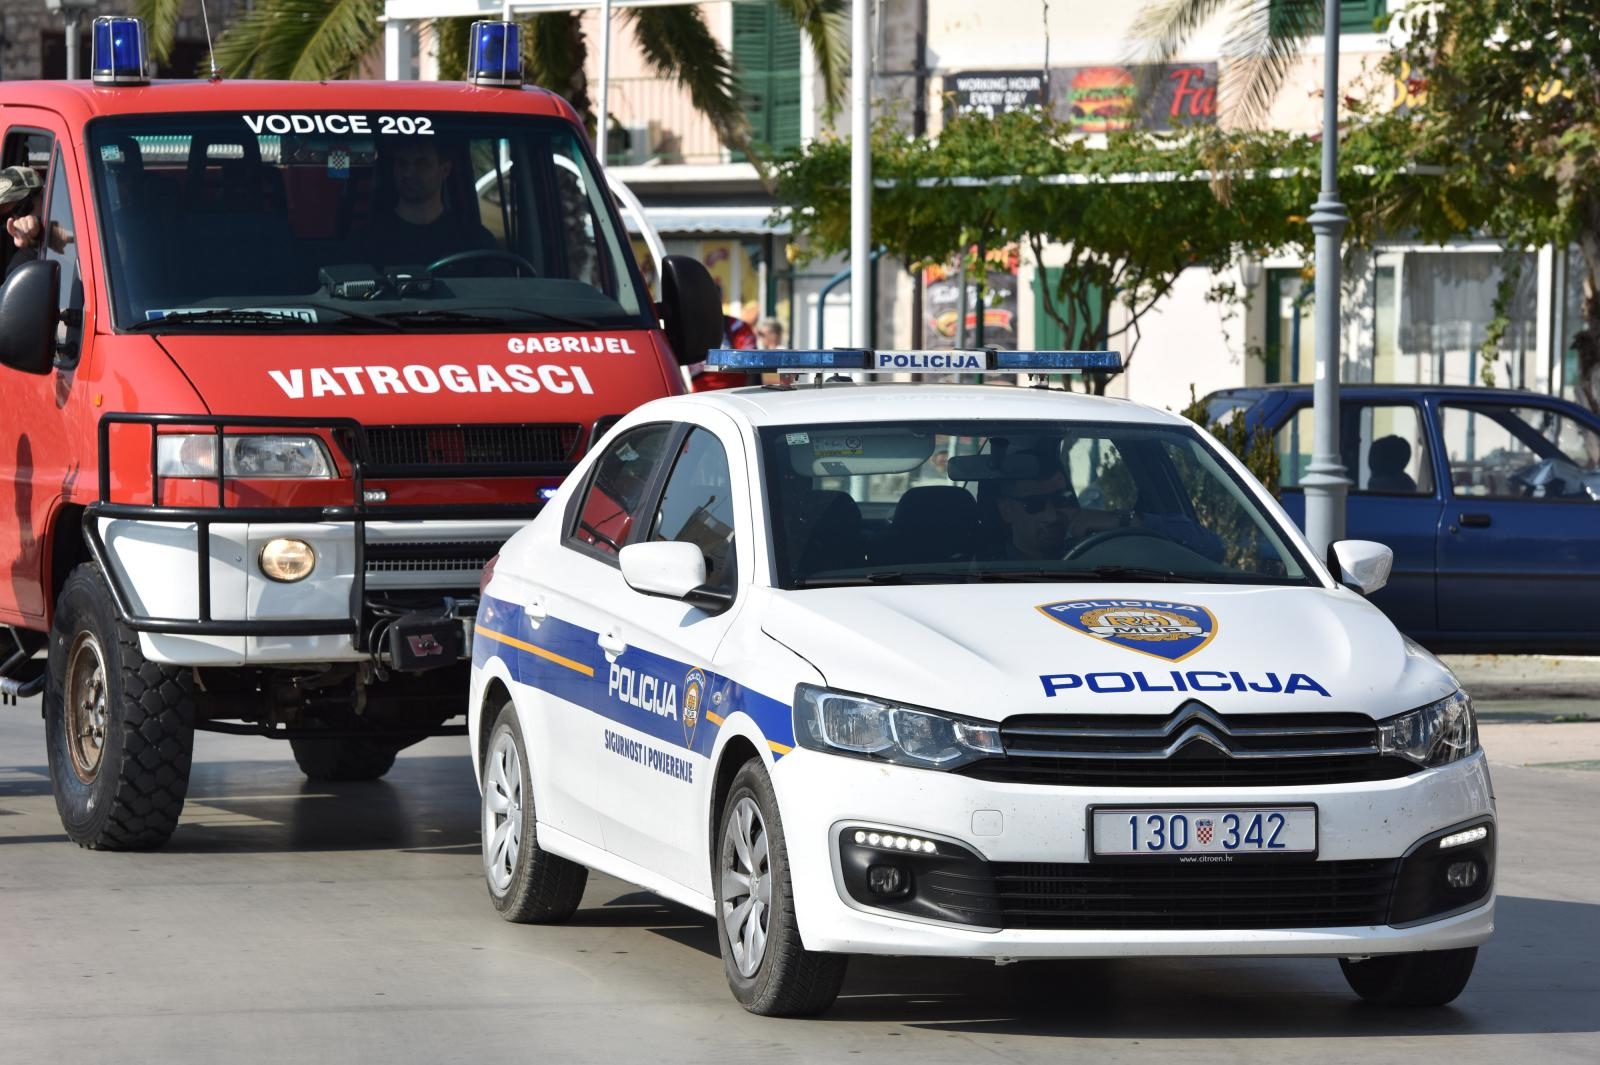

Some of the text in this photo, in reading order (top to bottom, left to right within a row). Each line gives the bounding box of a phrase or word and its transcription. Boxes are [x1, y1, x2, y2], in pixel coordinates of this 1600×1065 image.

[957, 77, 1040, 91] WORKING HOUR
[970, 91, 1027, 105] EVERY DAY
[243, 115, 435, 135] VODICE 202
[507, 336, 635, 354] GABRIJEL
[880, 354, 980, 368] POLICIJA
[268, 364, 594, 399] VATROGASCI
[1050, 600, 1199, 613] POLICIJA
[1113, 626, 1181, 634] MUP
[608, 662, 678, 721] POLICIJA
[1039, 671, 1332, 697] POLICIJA
[604, 729, 693, 784] SIGURNOST I POVJERENJE
[1128, 813, 1286, 851] 130 342
[1179, 853, 1233, 863] www.citroen.hr
